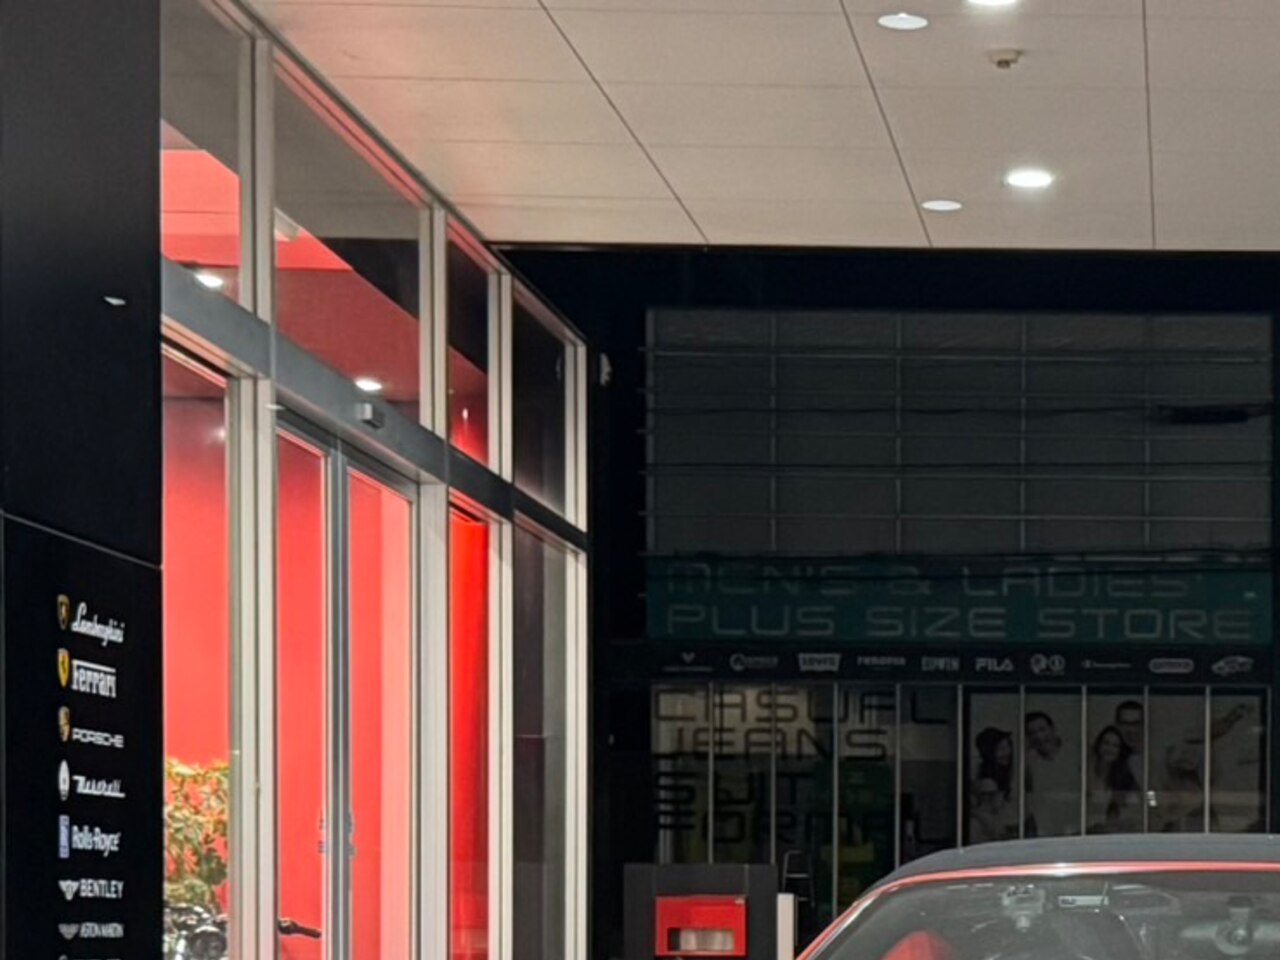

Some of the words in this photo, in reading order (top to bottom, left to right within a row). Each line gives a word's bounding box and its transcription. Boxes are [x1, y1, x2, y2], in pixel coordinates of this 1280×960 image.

[667, 604, 836, 637] PLUS
[865, 605, 1006, 638] SIZE
[1038, 607, 1252, 640] STORE
[975, 657, 1014, 672] FILA
[72, 659, 117, 698] Ferrari
[72, 728, 125, 748] PORSCHE
[79, 879, 124, 899] BENTLEY
